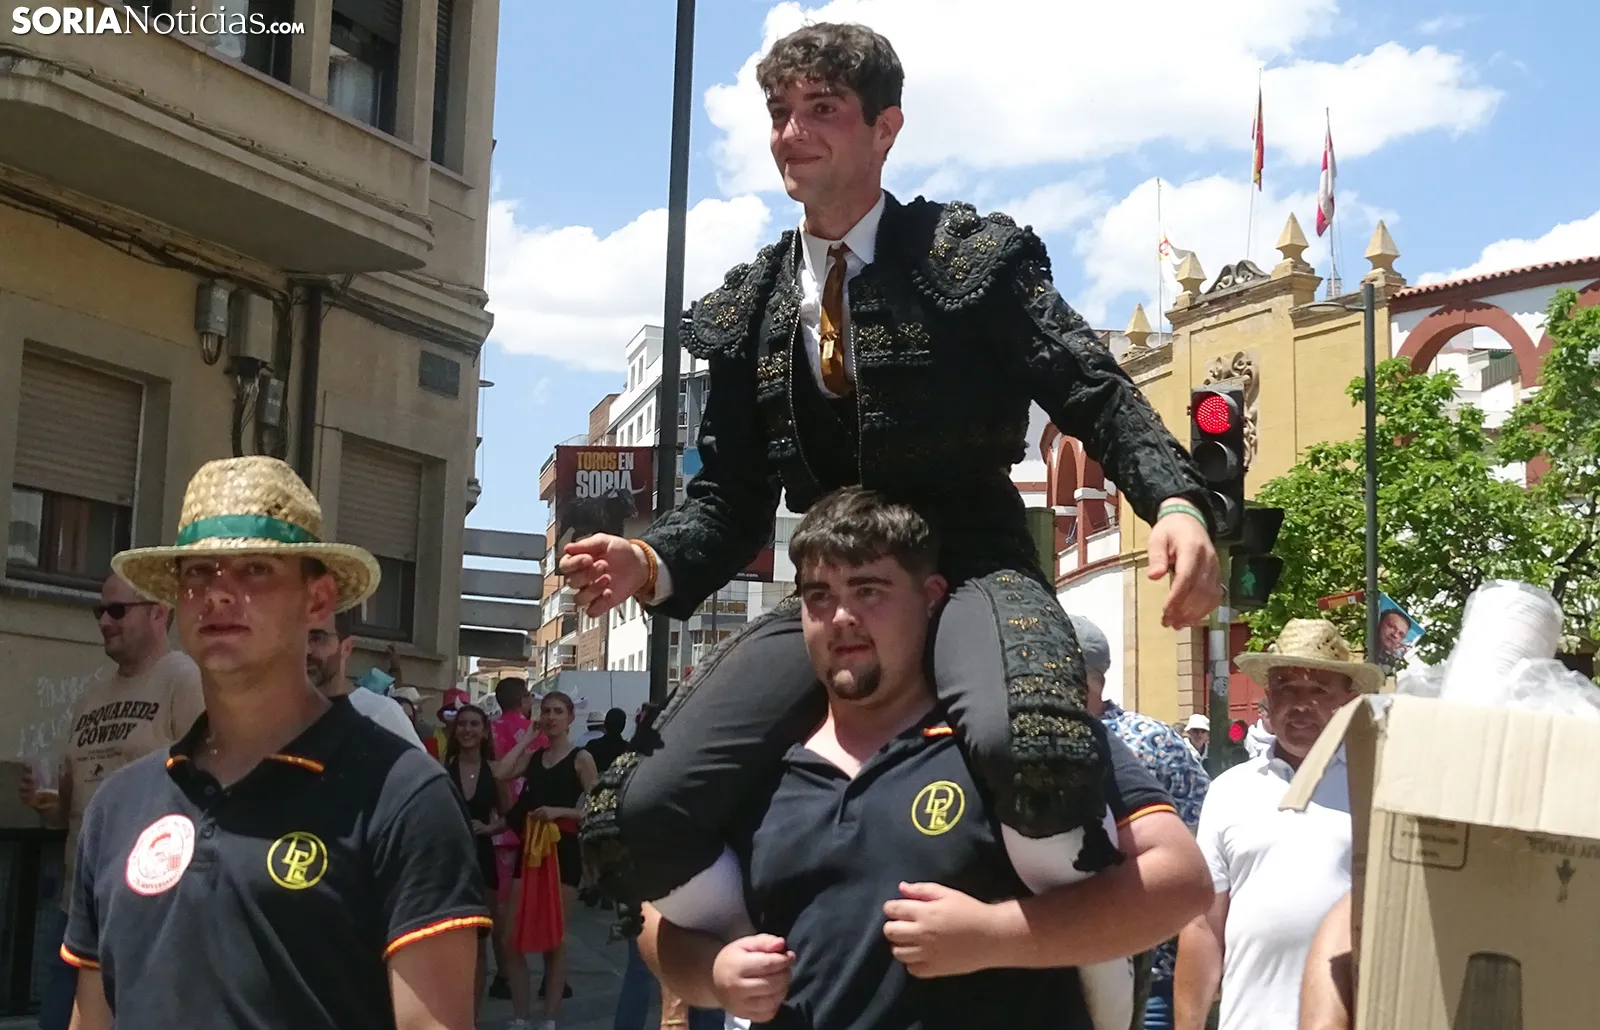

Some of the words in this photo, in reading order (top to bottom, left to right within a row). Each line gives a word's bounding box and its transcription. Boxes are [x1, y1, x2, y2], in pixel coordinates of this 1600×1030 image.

[576, 452, 617, 470] TOROS
[618, 452, 634, 470] EN
[576, 470, 632, 498] SORIA
[75, 701, 159, 732] DSQUARED2
[77, 722, 137, 748] COWBOY
